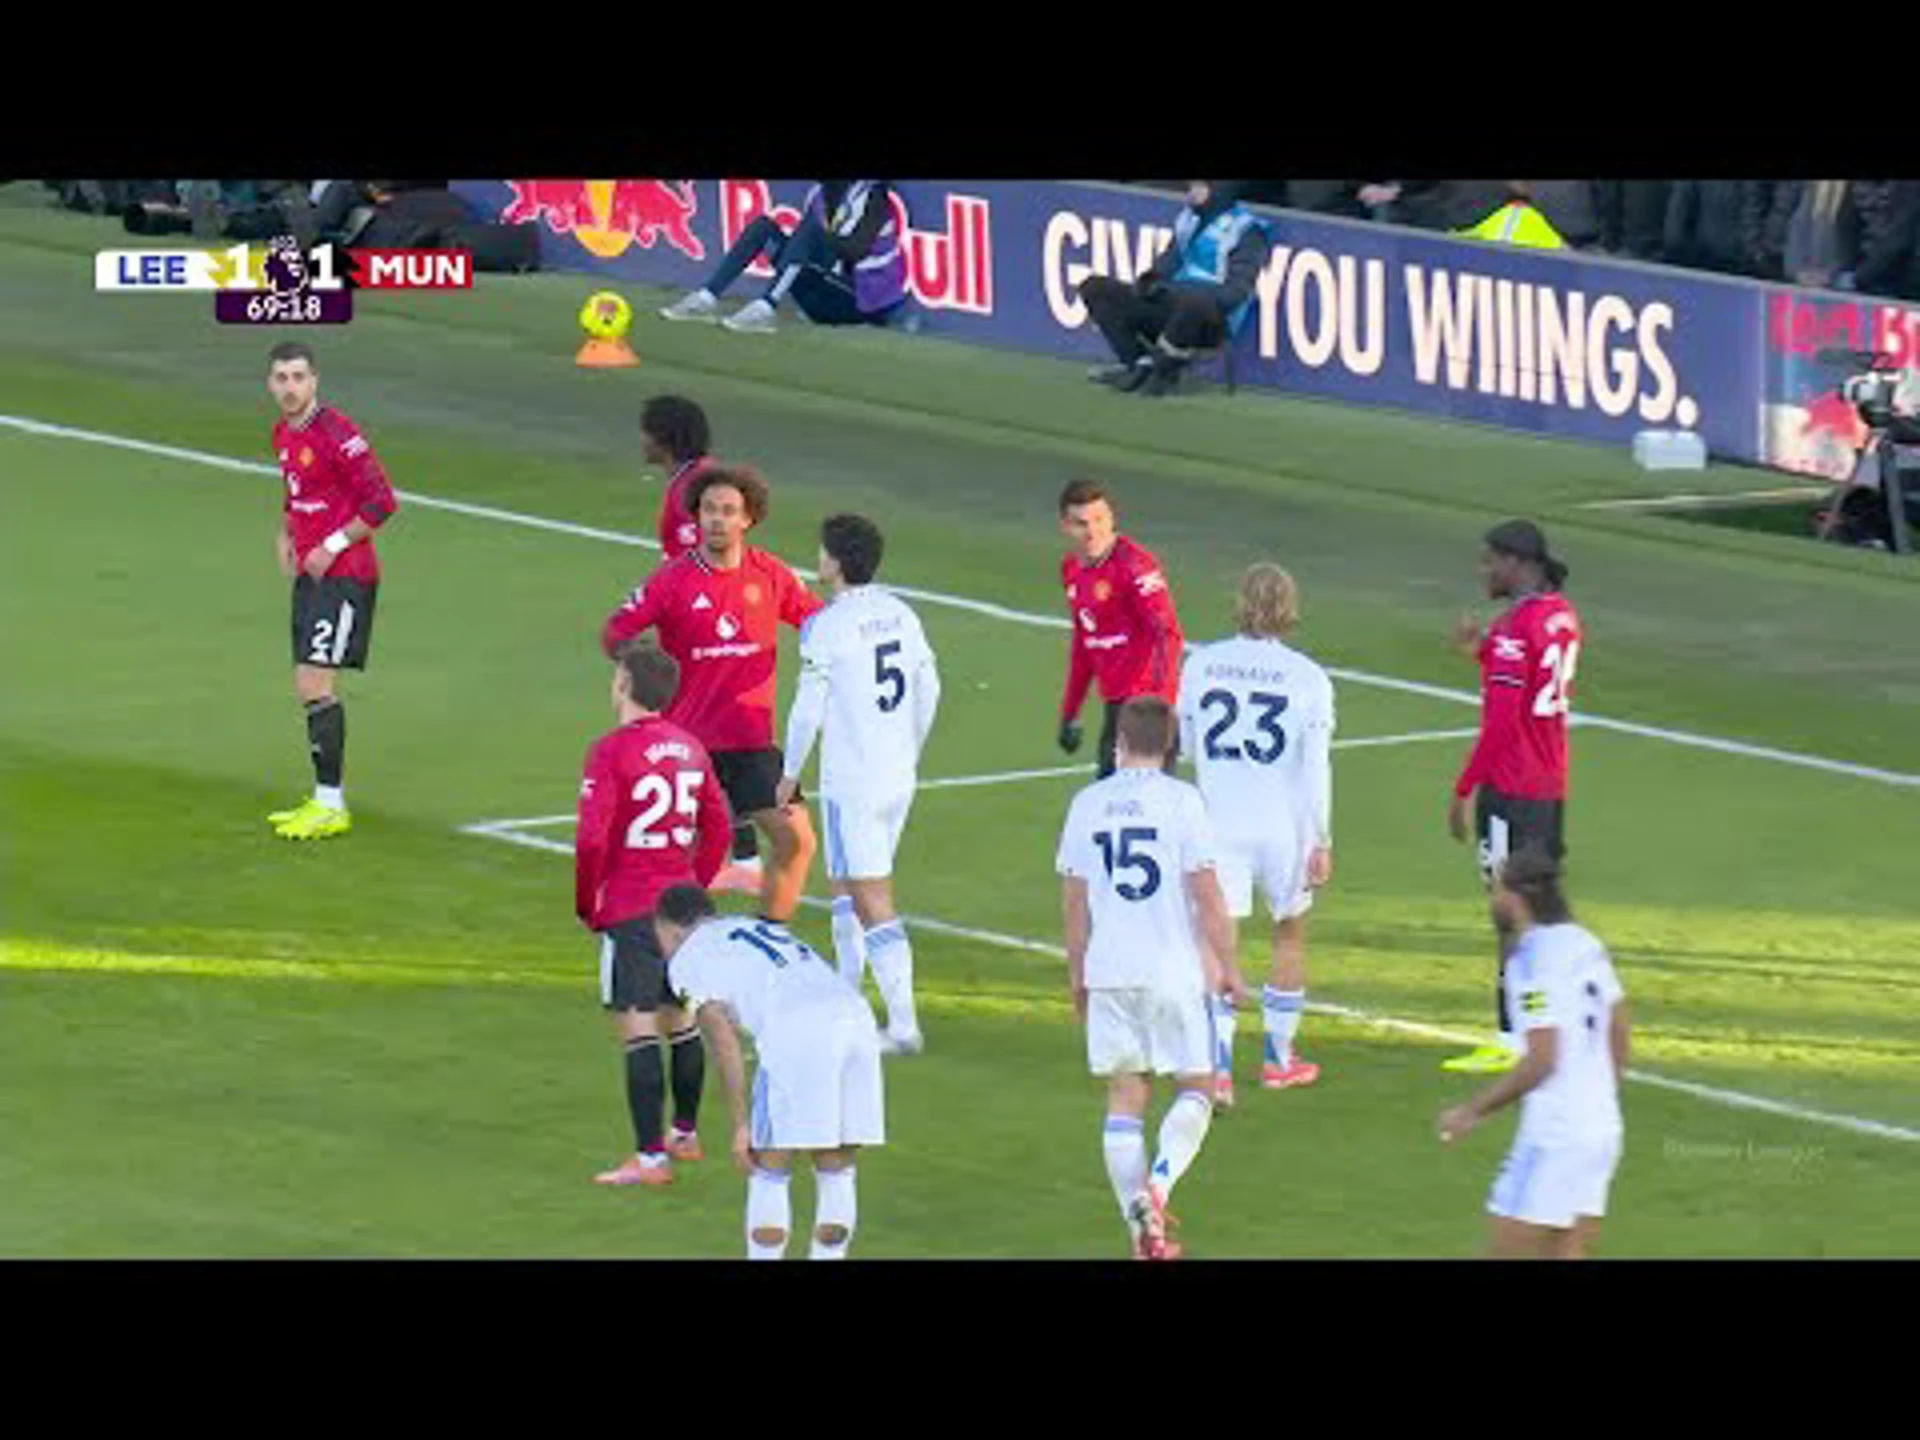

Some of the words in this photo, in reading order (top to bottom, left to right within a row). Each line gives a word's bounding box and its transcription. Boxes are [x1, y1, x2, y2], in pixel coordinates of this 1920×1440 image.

[1255, 243, 1385, 376] YOU
[310, 619, 334, 650] 2
[874, 639, 906, 713] 5
[1200, 689, 1290, 765] 23
[625, 770, 704, 849] 25
[1092, 827, 1162, 902] 15
